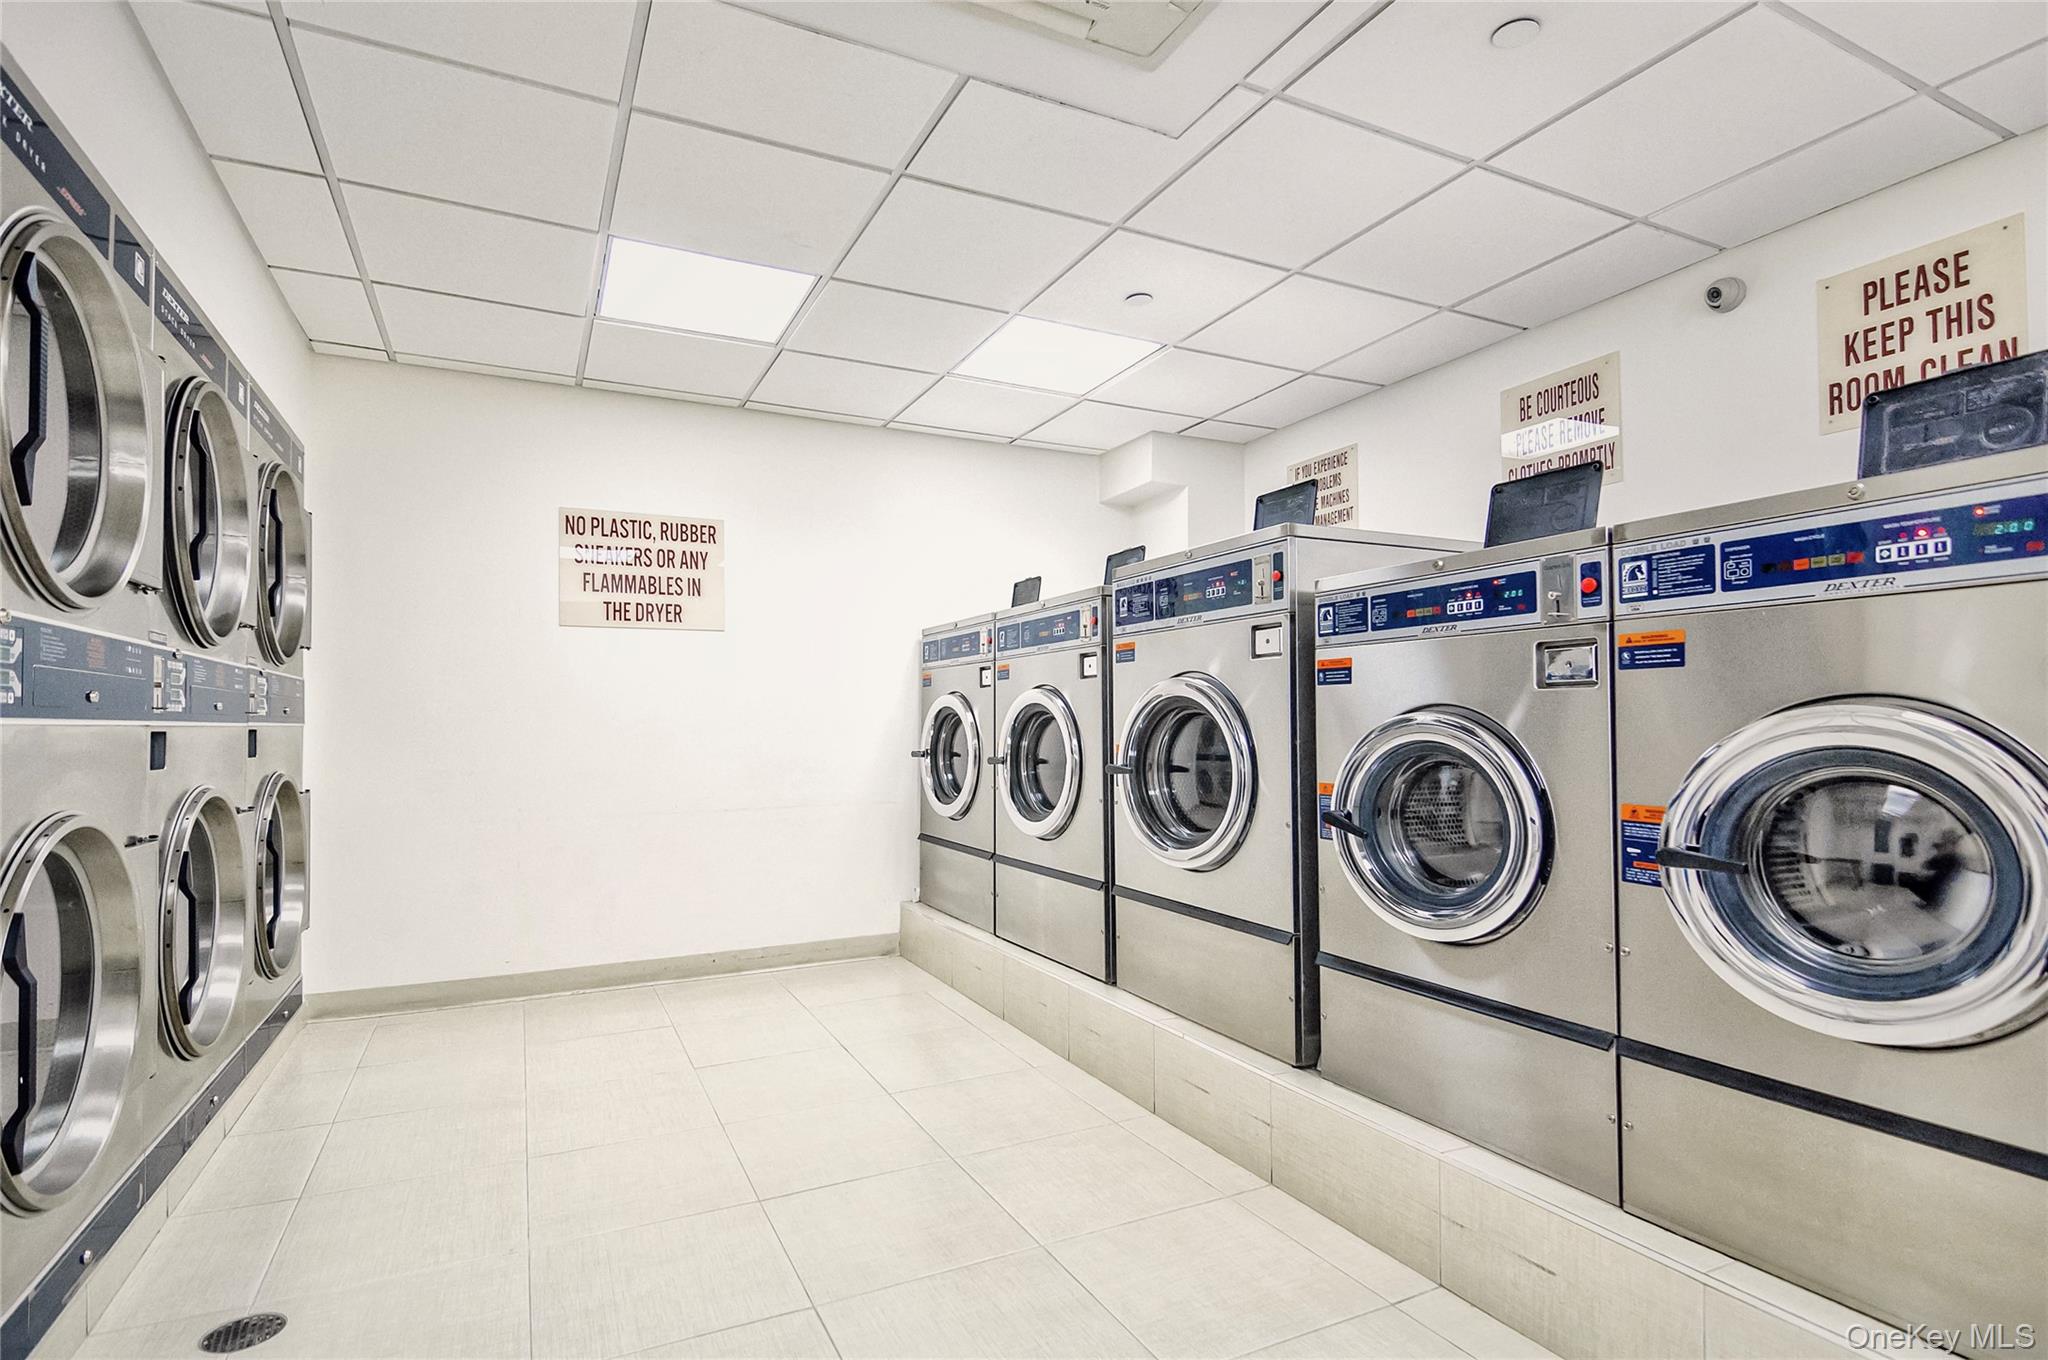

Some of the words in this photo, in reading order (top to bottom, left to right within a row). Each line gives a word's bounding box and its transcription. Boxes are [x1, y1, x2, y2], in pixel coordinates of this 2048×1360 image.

[0, 80, 34, 133] XTER
[1862, 250, 1971, 316] PLEASE
[1844, 316, 1915, 367] KEEP
[1925, 293, 1996, 344] THIS
[1519, 394, 1532, 423] BE
[1536, 372, 1600, 417] COURTEOUS
[1828, 365, 1905, 416] ROOM
[1515, 422, 1554, 457] PLEASE
[1559, 407, 1605, 446] REMOVE
[1295, 467, 1300, 480] IF
[1302, 463, 1312, 479] YOU
[1313, 451, 1348, 476] EXPERIENCE
[1319, 471, 1342, 492] OBLEMS
[1320, 488, 1350, 509] MACHINES
[565, 514, 586, 536] NO
[591, 516, 657, 544] PLASTIC,
[660, 521, 717, 545] RUBBER
[1315, 505, 1354, 527] MANAGEMENT
[574, 543, 653, 568] SNEAKERS
[656, 548, 676, 569] OR
[679, 550, 709, 571] ANY
[583, 572, 684, 597] FLAMMABLES
[687, 577, 701, 597] IN
[1823, 576, 1897, 593] DEXTER
[603, 600, 632, 622] THE
[635, 602, 683, 624] DRYER
[1421, 624, 1458, 634] DEXTER
